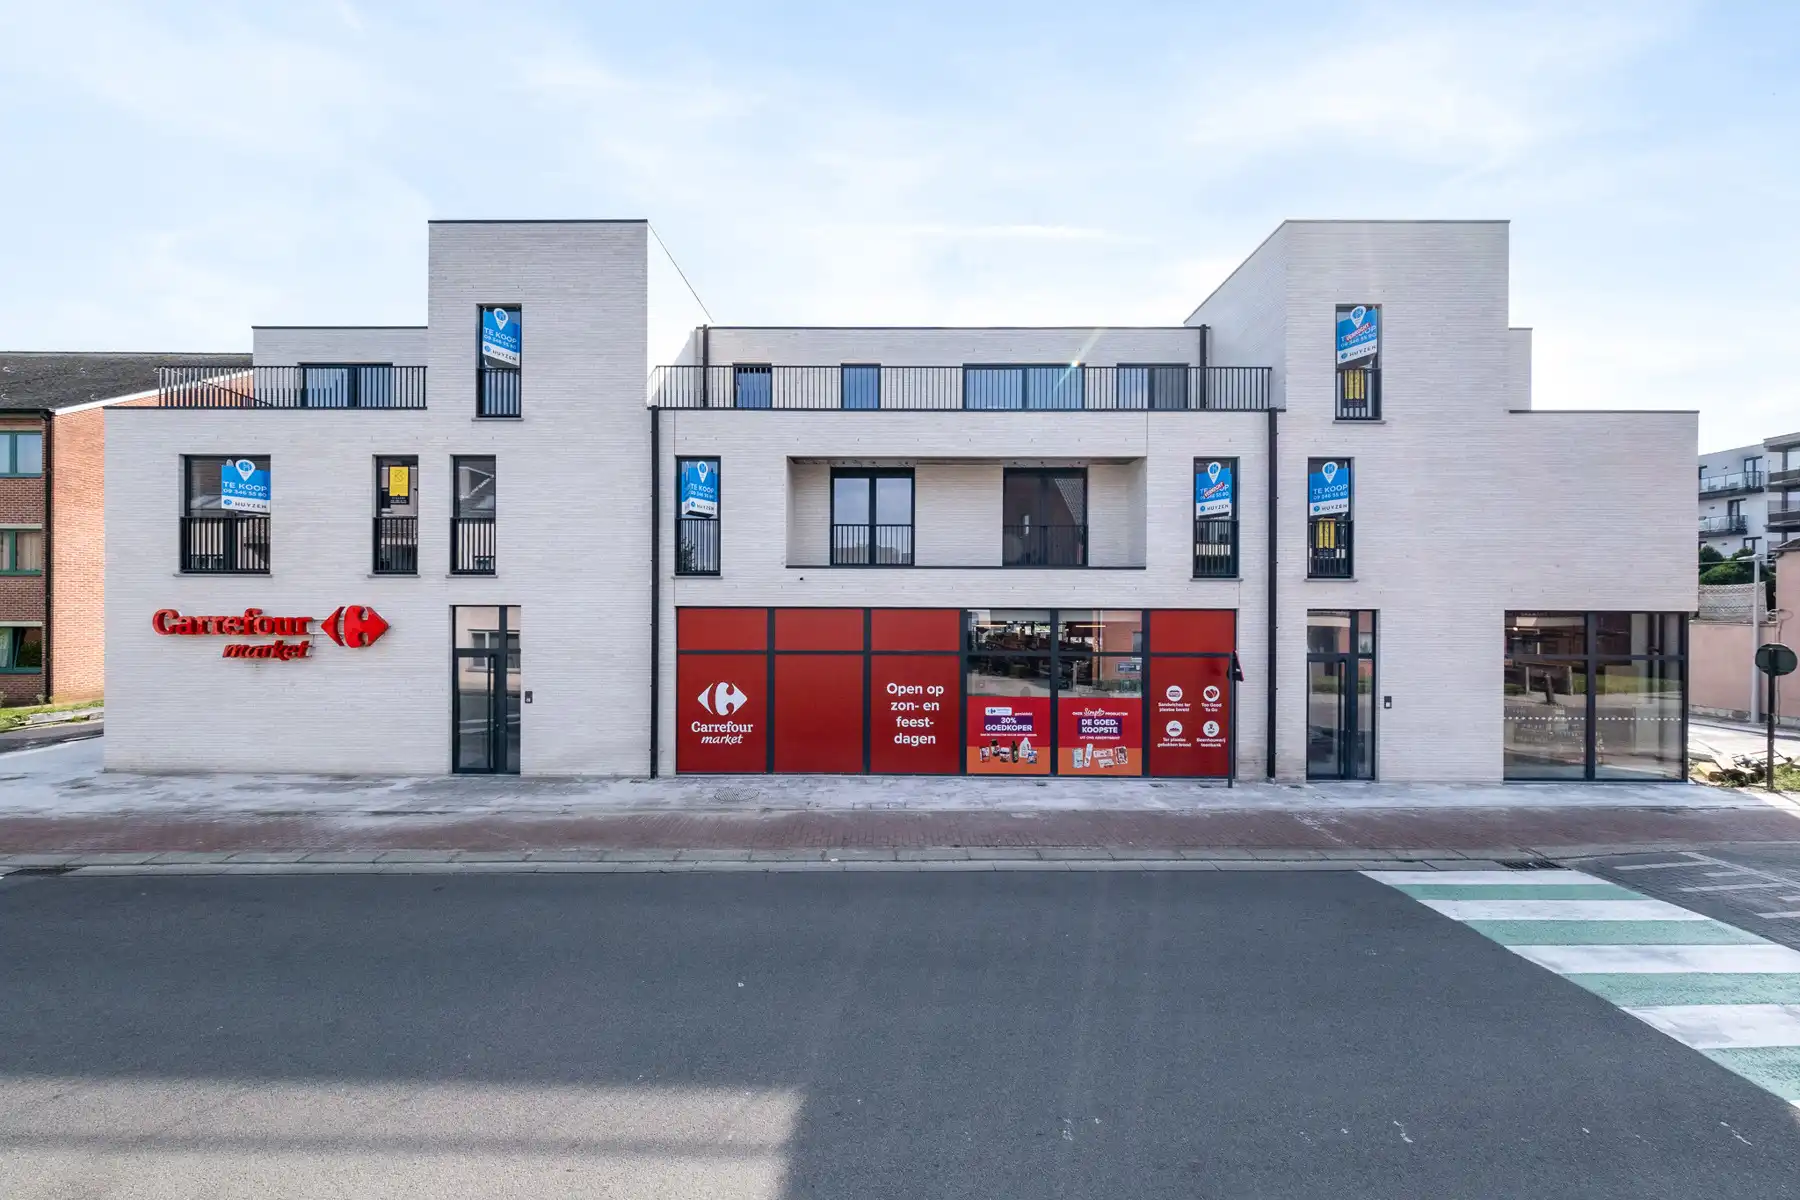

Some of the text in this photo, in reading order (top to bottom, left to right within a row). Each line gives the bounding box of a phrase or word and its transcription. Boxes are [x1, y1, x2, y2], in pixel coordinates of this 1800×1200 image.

[484, 326, 516, 343] TE KOOP
[492, 349, 517, 361] HUYZEN
[1350, 346, 1376, 356] HUYZEN
[238, 484, 267, 492] KOOP
[1324, 484, 1348, 492] KOOP
[152, 608, 313, 636] Carrefour
[223, 640, 310, 661] market
[887, 683, 944, 697] Open op
[891, 702, 940, 710] zon- en
[691, 721, 753, 732] Carrefour
[896, 716, 934, 727] feest-
[701, 734, 743, 745] market
[894, 733, 936, 746] dagen
